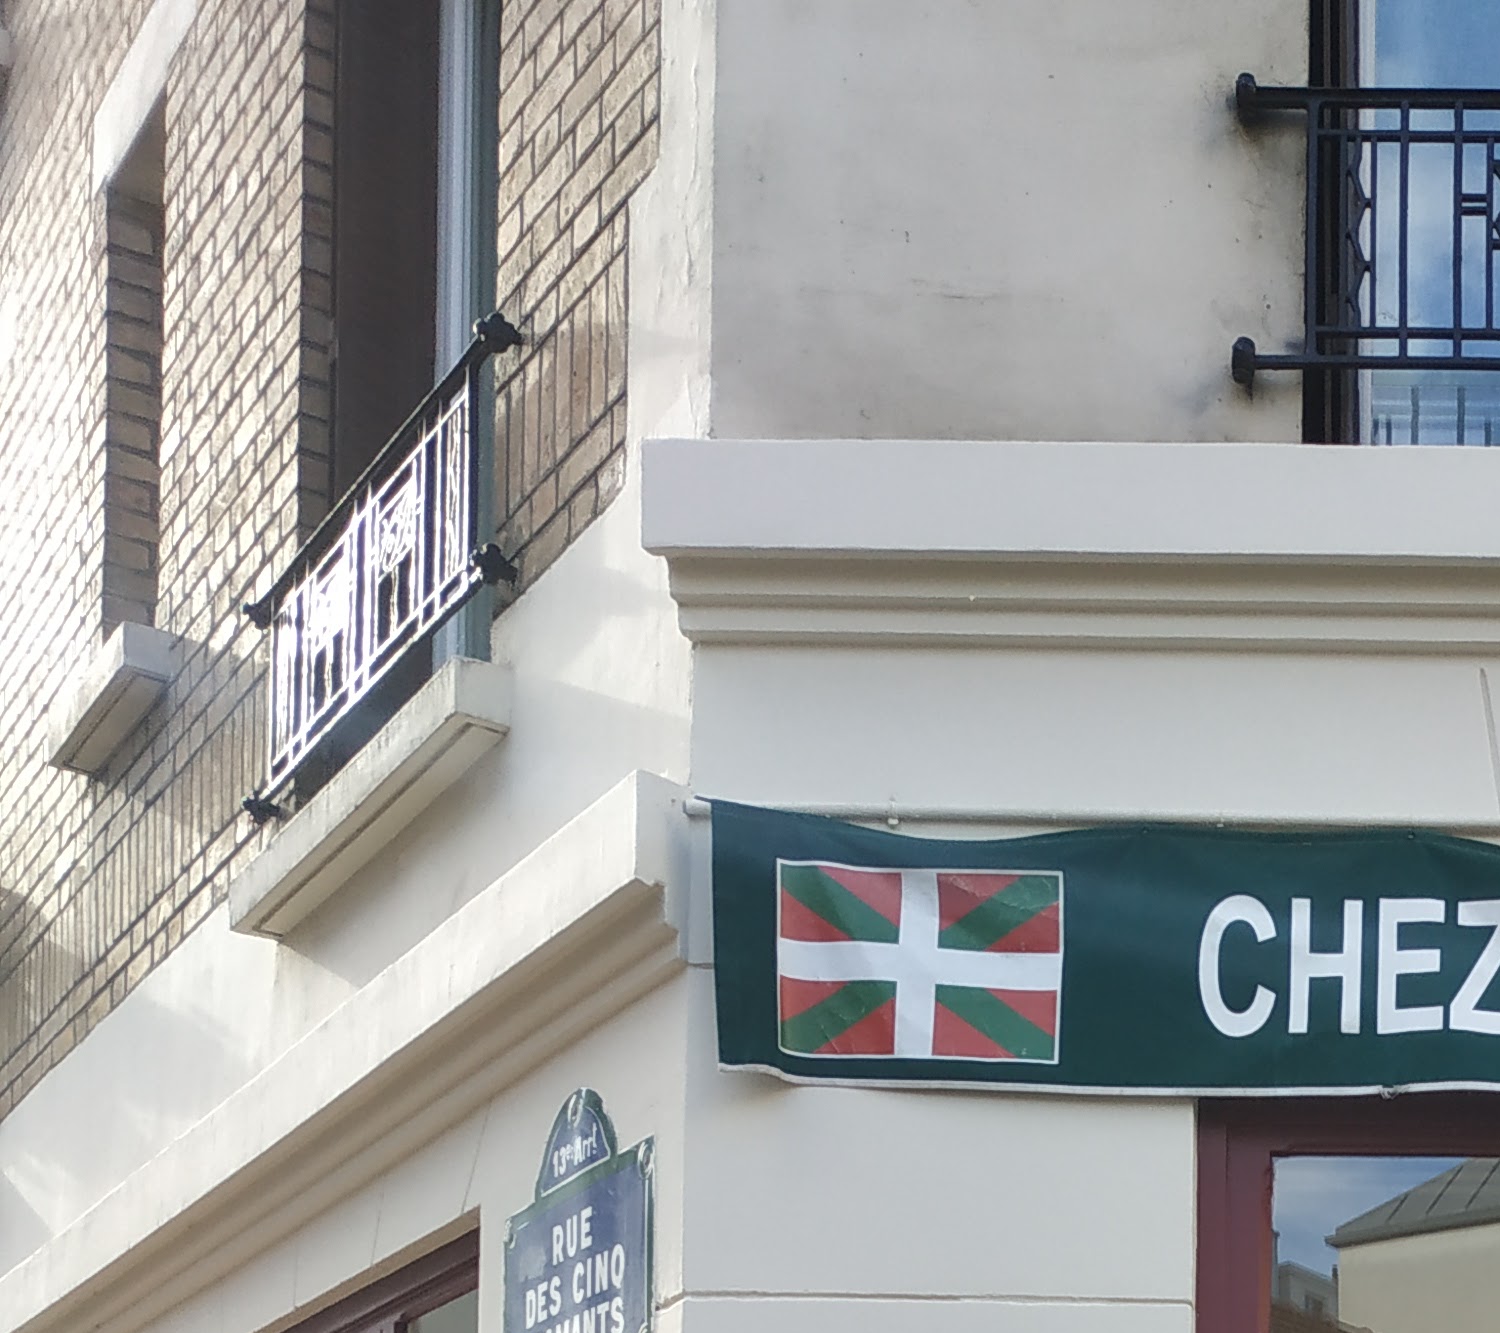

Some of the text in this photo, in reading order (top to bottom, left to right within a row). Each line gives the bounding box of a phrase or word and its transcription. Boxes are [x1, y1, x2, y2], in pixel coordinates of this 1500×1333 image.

[552, 1205, 593, 1266] RUE
[525, 1243, 626, 1330] DES CINQ
